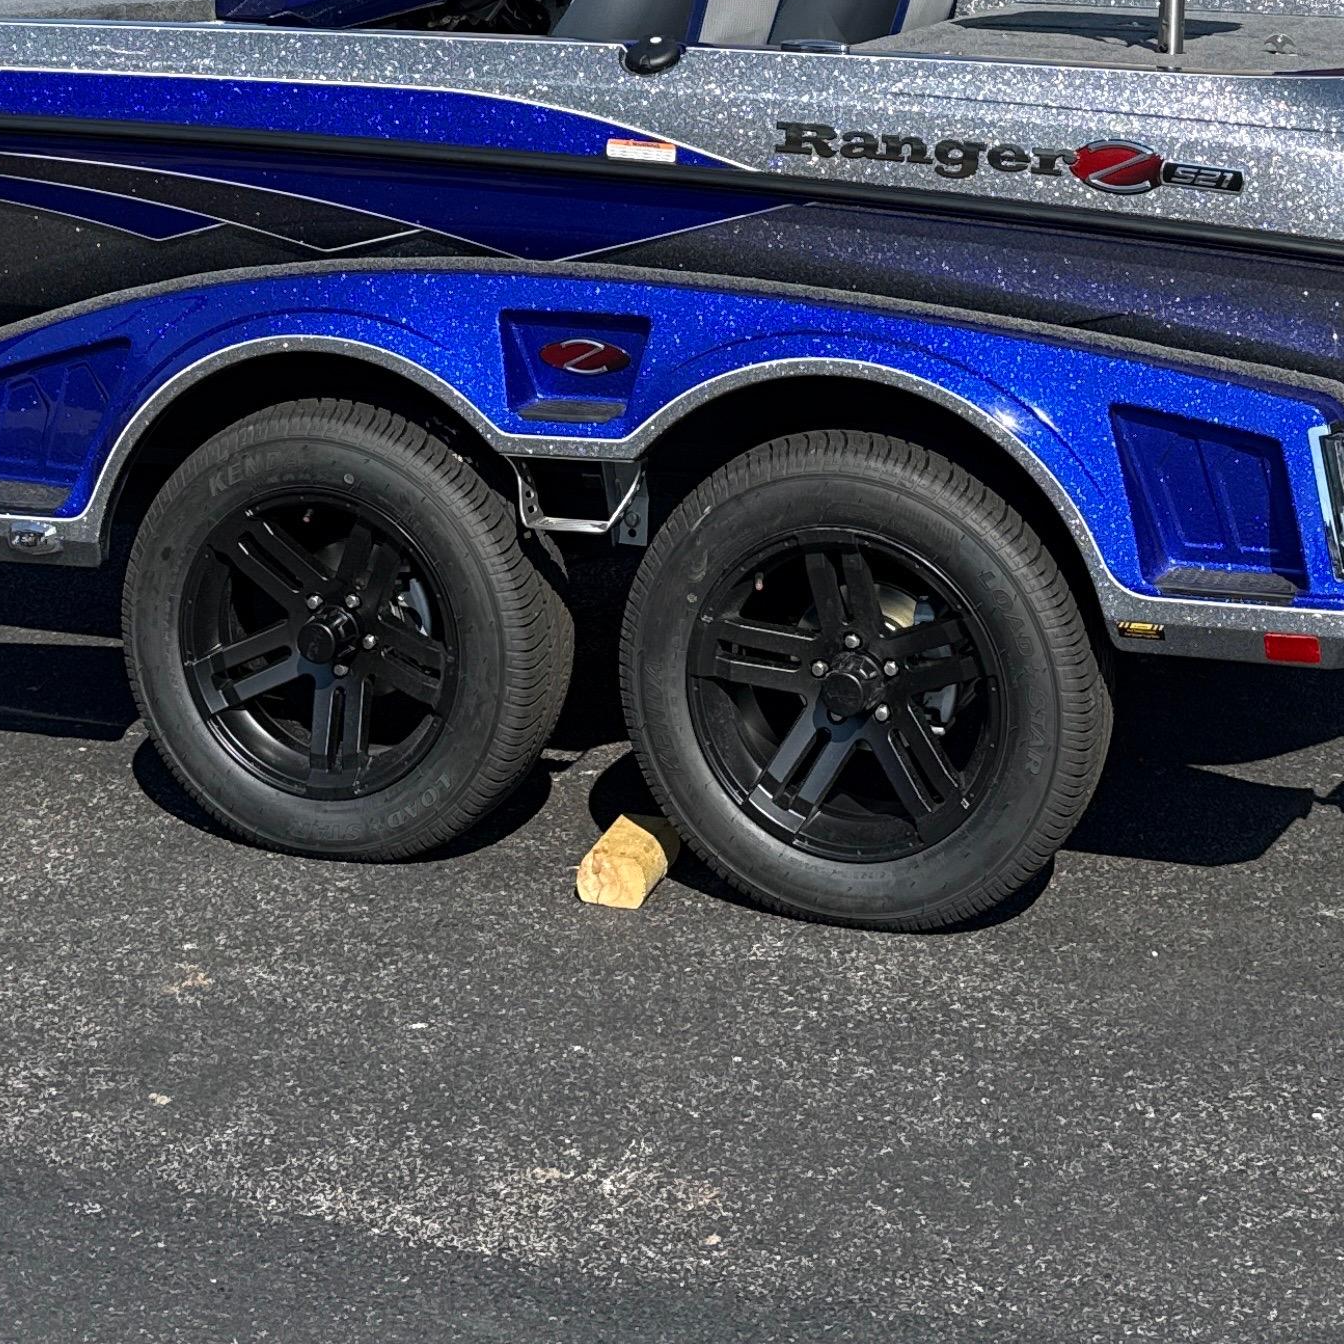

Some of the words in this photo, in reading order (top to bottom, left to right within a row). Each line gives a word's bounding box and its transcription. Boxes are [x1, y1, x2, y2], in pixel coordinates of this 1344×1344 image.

[775, 121, 1078, 179] Ranger
[1170, 166, 1234, 188] 521
[386, 772, 453, 829] LOAD
